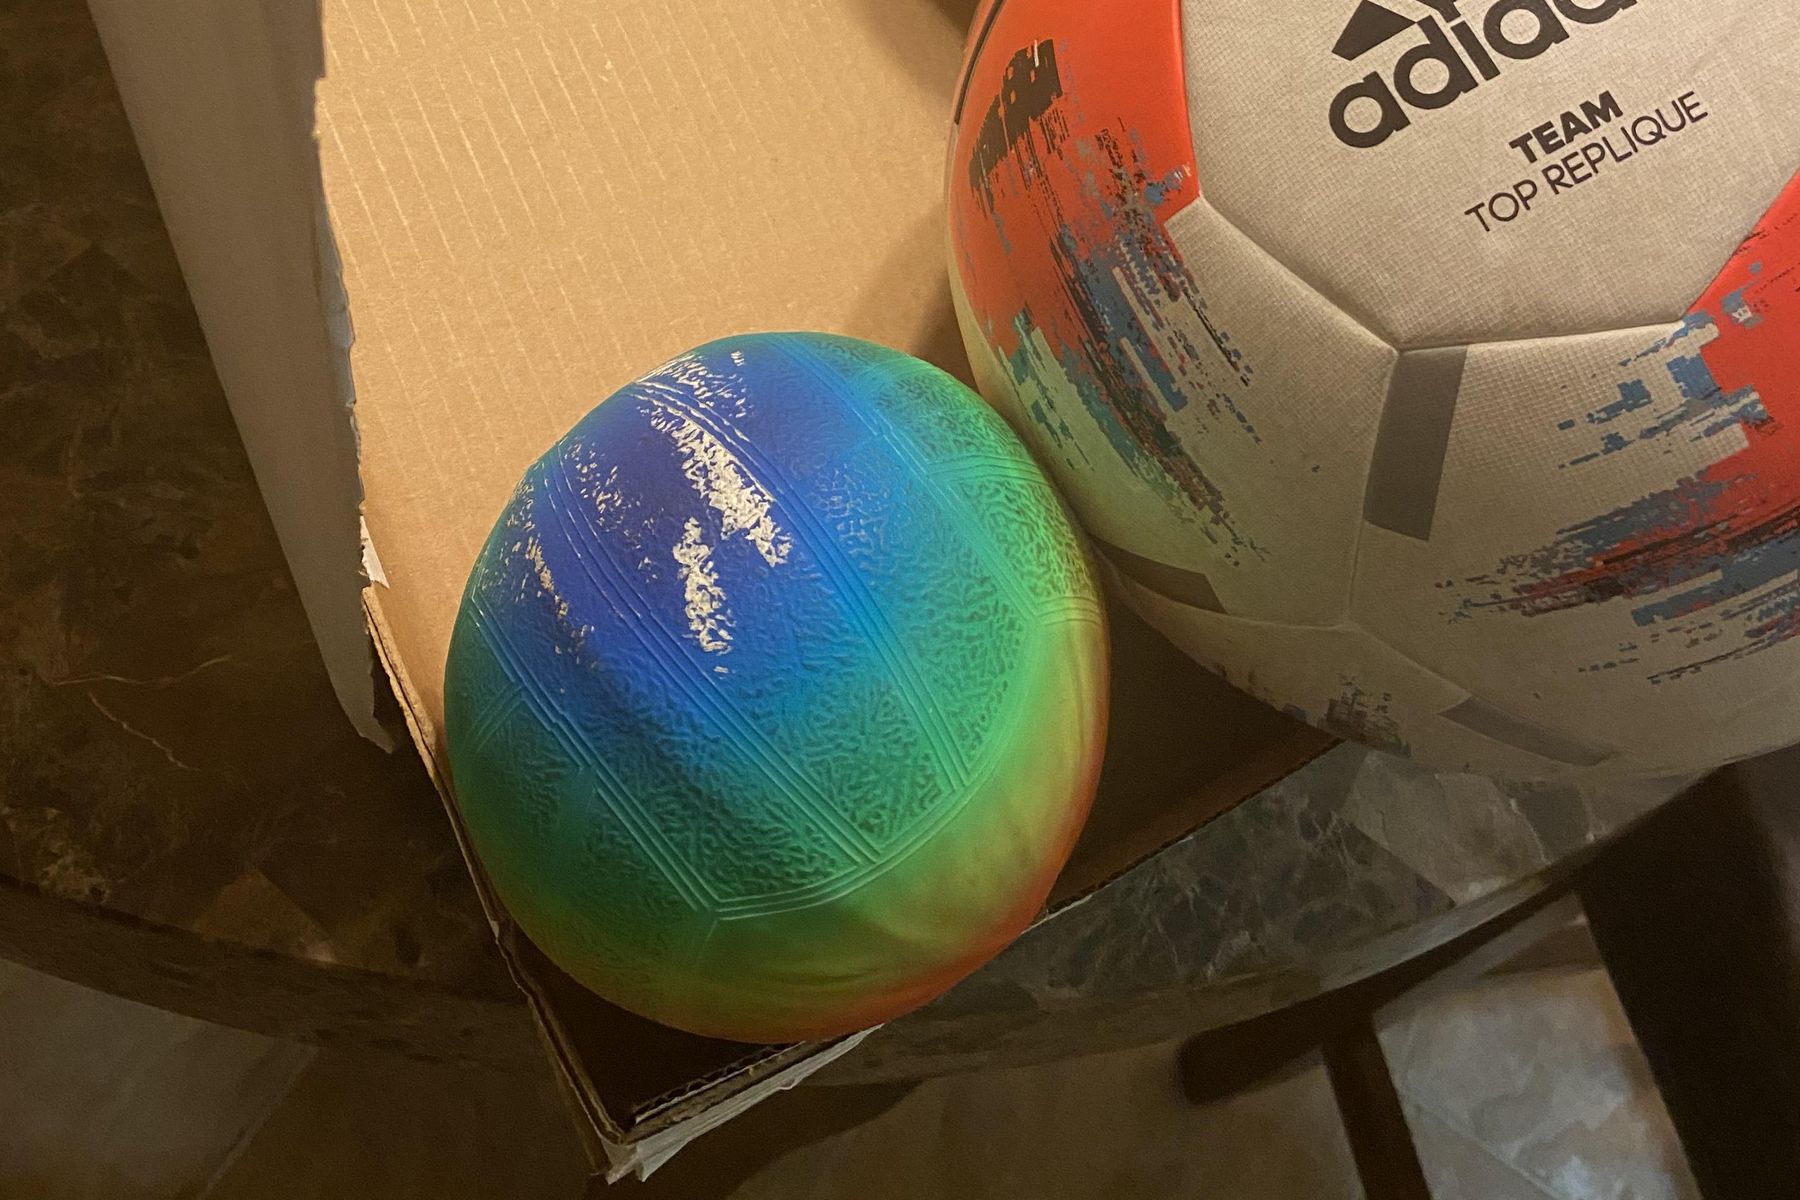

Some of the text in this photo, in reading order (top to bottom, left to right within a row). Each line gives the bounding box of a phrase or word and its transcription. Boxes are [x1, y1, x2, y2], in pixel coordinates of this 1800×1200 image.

[1464, 90, 1709, 232] TOP REPLIQUE
[1508, 90, 1624, 164] TEAM
